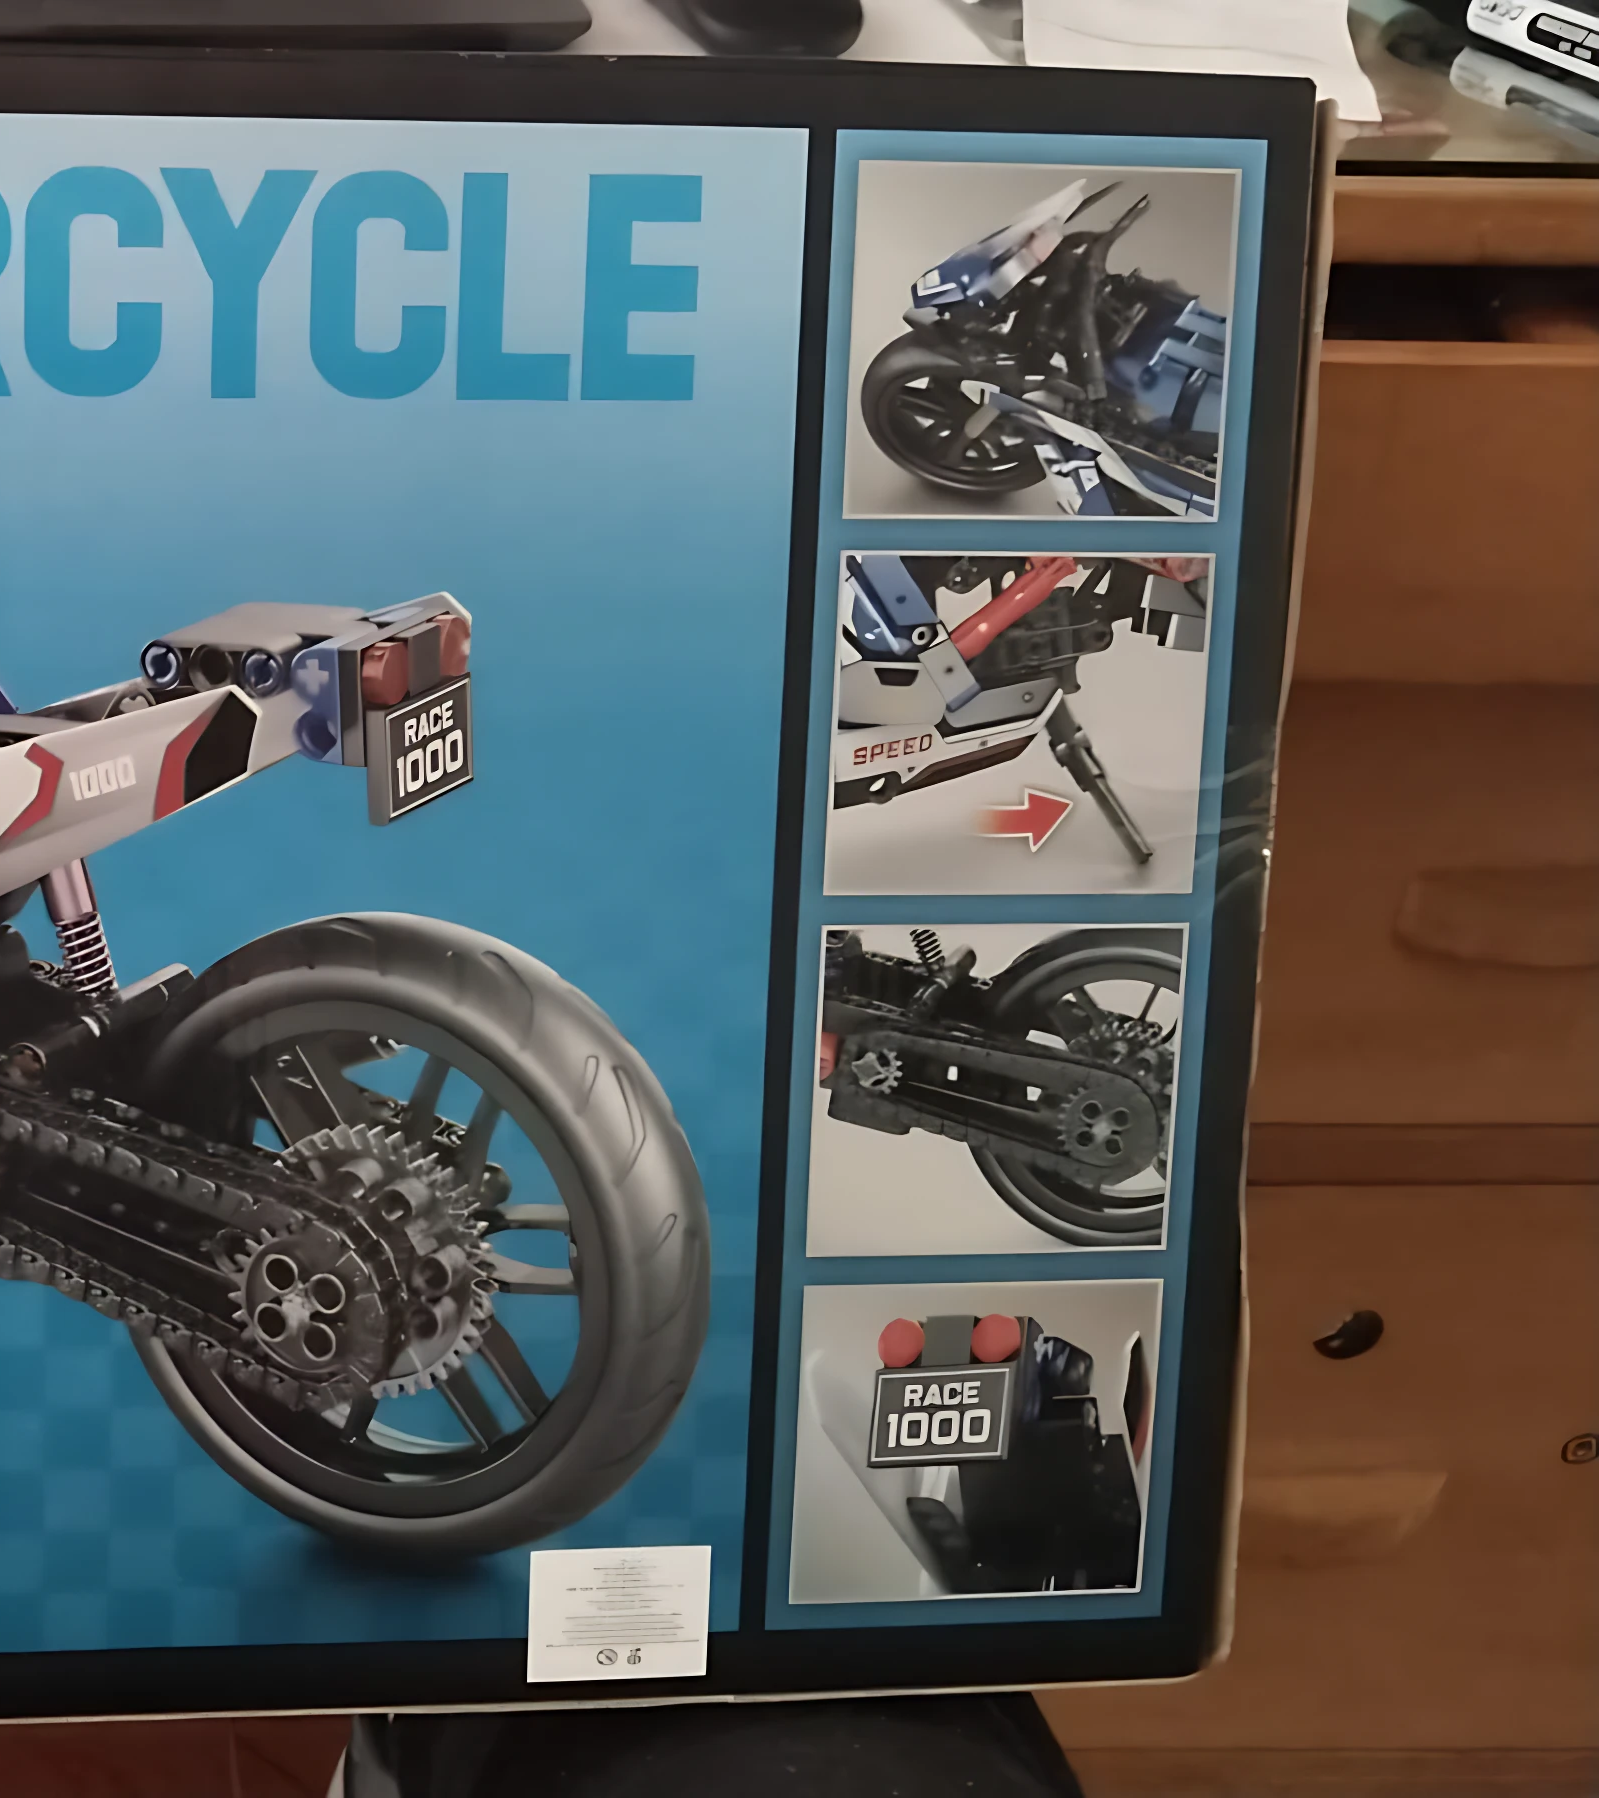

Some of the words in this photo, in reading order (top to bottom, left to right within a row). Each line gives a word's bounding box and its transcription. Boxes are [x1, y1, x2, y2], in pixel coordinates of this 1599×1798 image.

[404, 700, 454, 747] RACE
[396, 728, 464, 798] 1000
[853, 733, 933, 766] SPEED
[69, 754, 137, 801] 1000
[903, 1381, 981, 1407] RACE
[886, 1408, 991, 1448] 1000
